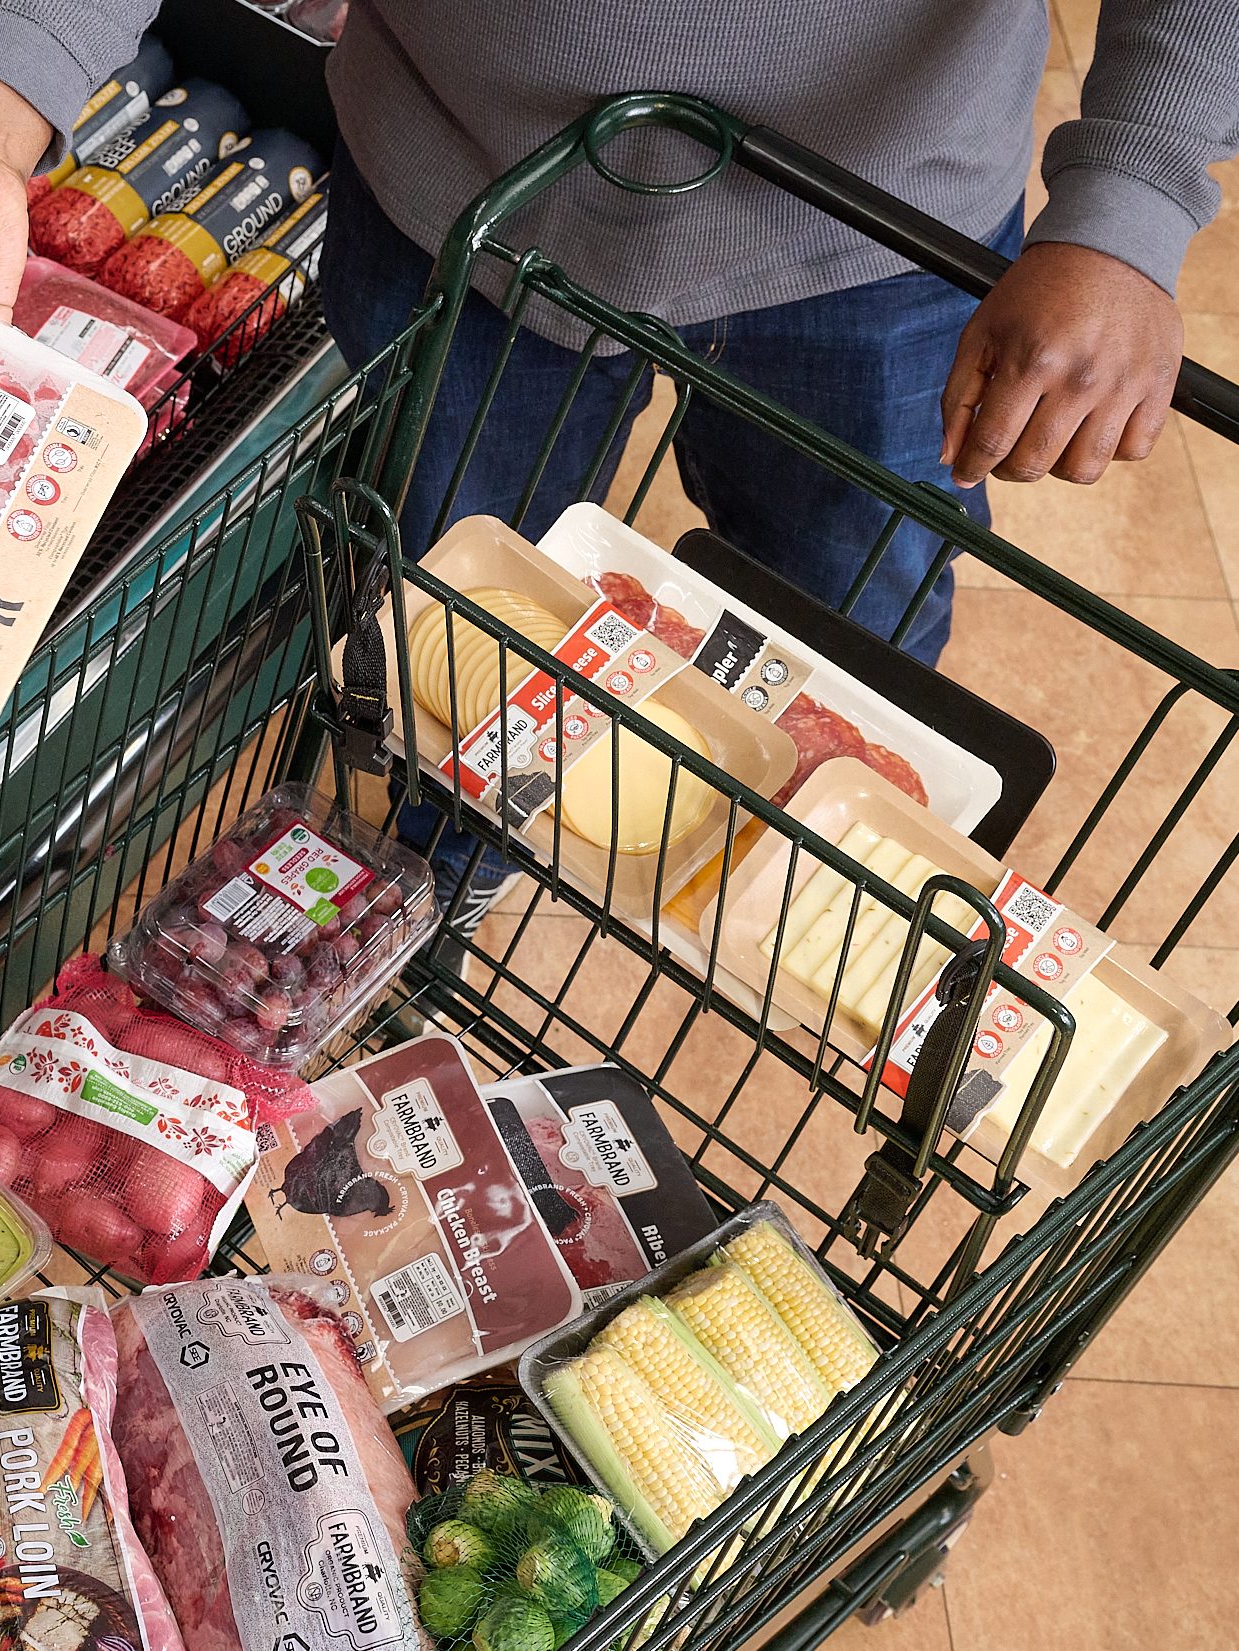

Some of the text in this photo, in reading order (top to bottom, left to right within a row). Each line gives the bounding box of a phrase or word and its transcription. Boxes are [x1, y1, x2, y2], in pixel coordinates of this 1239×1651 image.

[223, 192, 283, 255] GROUND
[531, 647, 598, 711] Slice eese
[477, 719, 528, 772] FARMRAND
[280, 861, 310, 885] GRAPES
[281, 849, 307, 872] SEEDLESS
[307, 847, 324, 863] RED
[1033, 953, 1063, 981] RECYCLE READY
[391, 1093, 437, 1170] FARMBRAND
[579, 1112, 630, 1187] FARMBRAND
[336, 1170, 398, 1237] FARMBRAND FRESH PACKAGE
[529, 1184, 587, 1207] RMBRAND FRESH
[436, 1188, 472, 1249] Chicken
[462, 1247, 498, 1305] Breast
[163, 1292, 192, 1340] CRYOVAC
[226, 1287, 265, 1337] FARMBRAND
[33, 1368, 44, 1393] QUALITY
[190, 1347, 202, 1362] SEE
[245, 1364, 319, 1493] ROUND
[280, 1362, 349, 1477] EYE OF
[455, 1401, 469, 1446] HAZELNUTS
[471, 1414, 486, 1454] ALMONDS
[511, 1413, 567, 1479] MIX
[47, 1474, 82, 1530] Fresh
[12, 1523, 62, 1599] LOIN
[355, 1525, 369, 1555] PREMIUM
[256, 1540, 291, 1626] CRYOVAC
[325, 1549, 350, 1618] ORGANIC PRODUCT
[328, 1521, 378, 1634] FARMBRAND
[328, 1599, 338, 1612] NC
[377, 1591, 390, 1621] QUALITY
